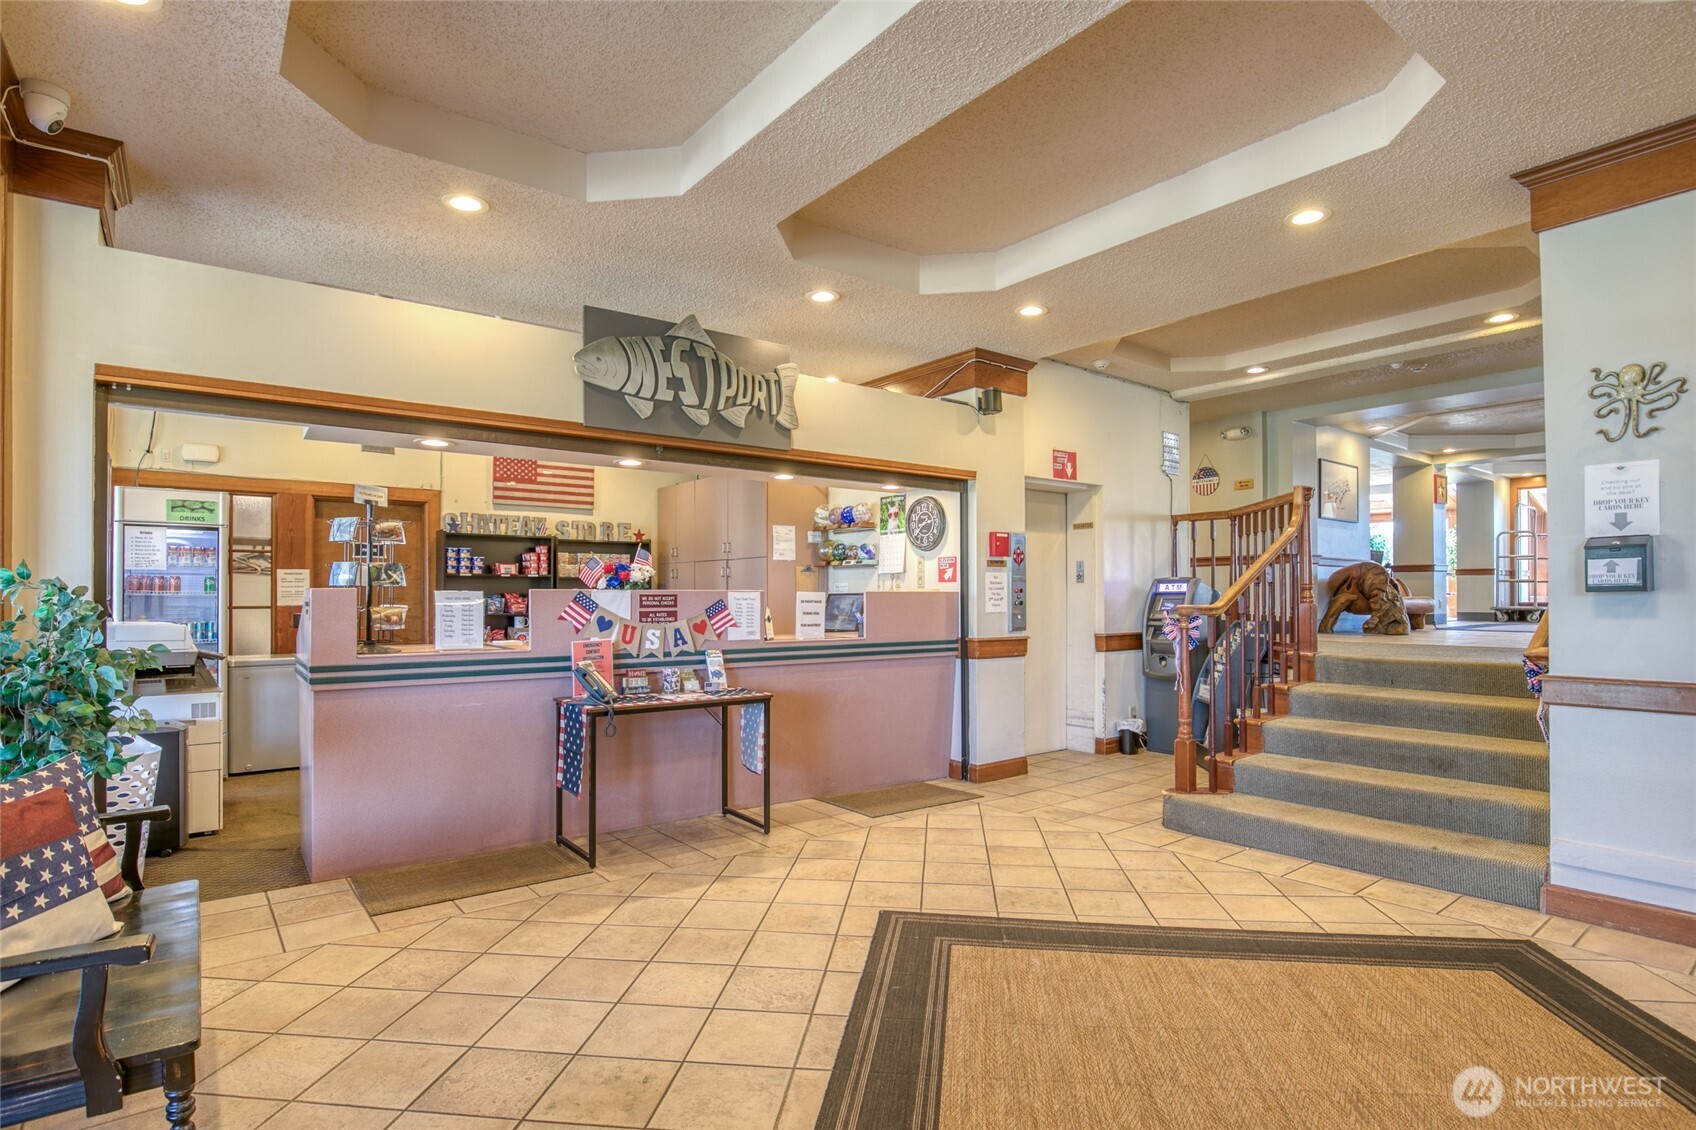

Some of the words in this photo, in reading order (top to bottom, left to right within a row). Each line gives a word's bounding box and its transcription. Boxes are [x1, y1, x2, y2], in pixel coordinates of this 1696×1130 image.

[619, 336, 781, 416] WESTPORT
[555, 520, 632, 541] STORE
[621, 623, 688, 650] USA
